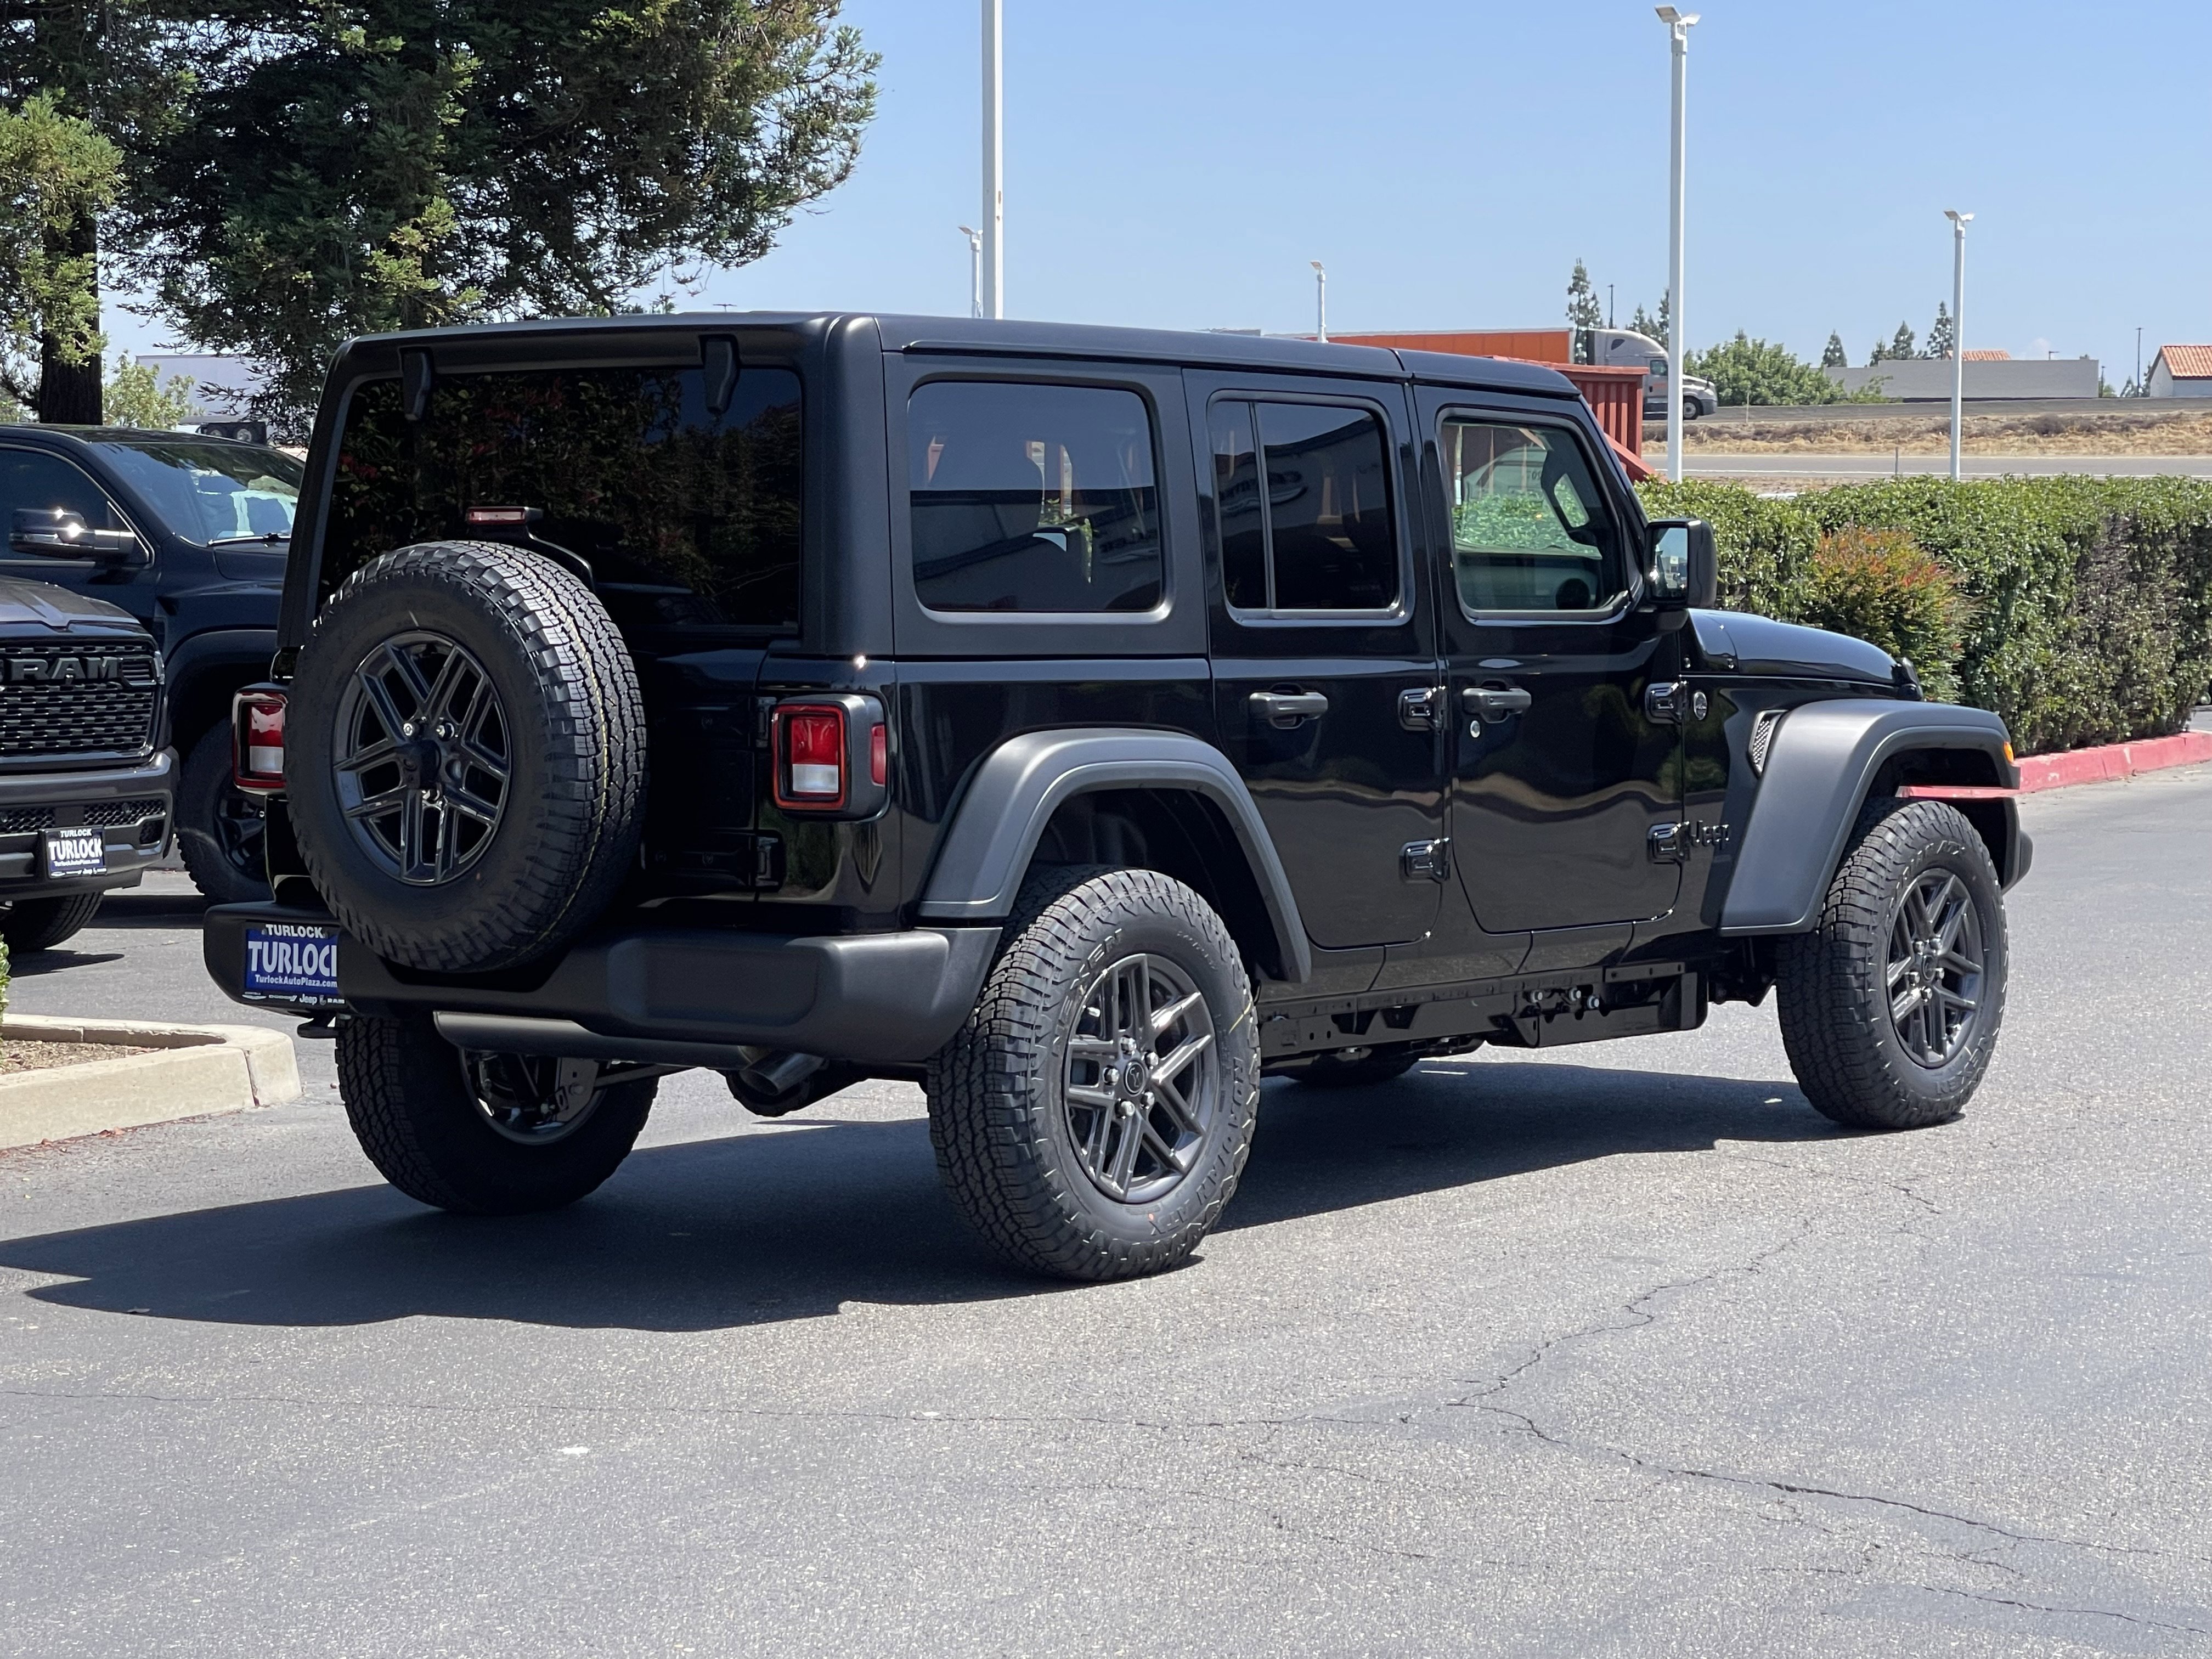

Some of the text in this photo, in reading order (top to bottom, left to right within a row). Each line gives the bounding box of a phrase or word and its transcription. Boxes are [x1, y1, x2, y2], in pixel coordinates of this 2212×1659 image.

[11, 657, 118, 681] RAM
[60, 828, 92, 838] TURLOCK
[1690, 820, 1730, 850] Jeep
[48, 838, 103, 861] TURLOCK
[266, 924, 324, 939] TURLOCK
[255, 974, 338, 988] TurlockAutoPlaza.com
[300, 994, 318, 1005] Jeep
